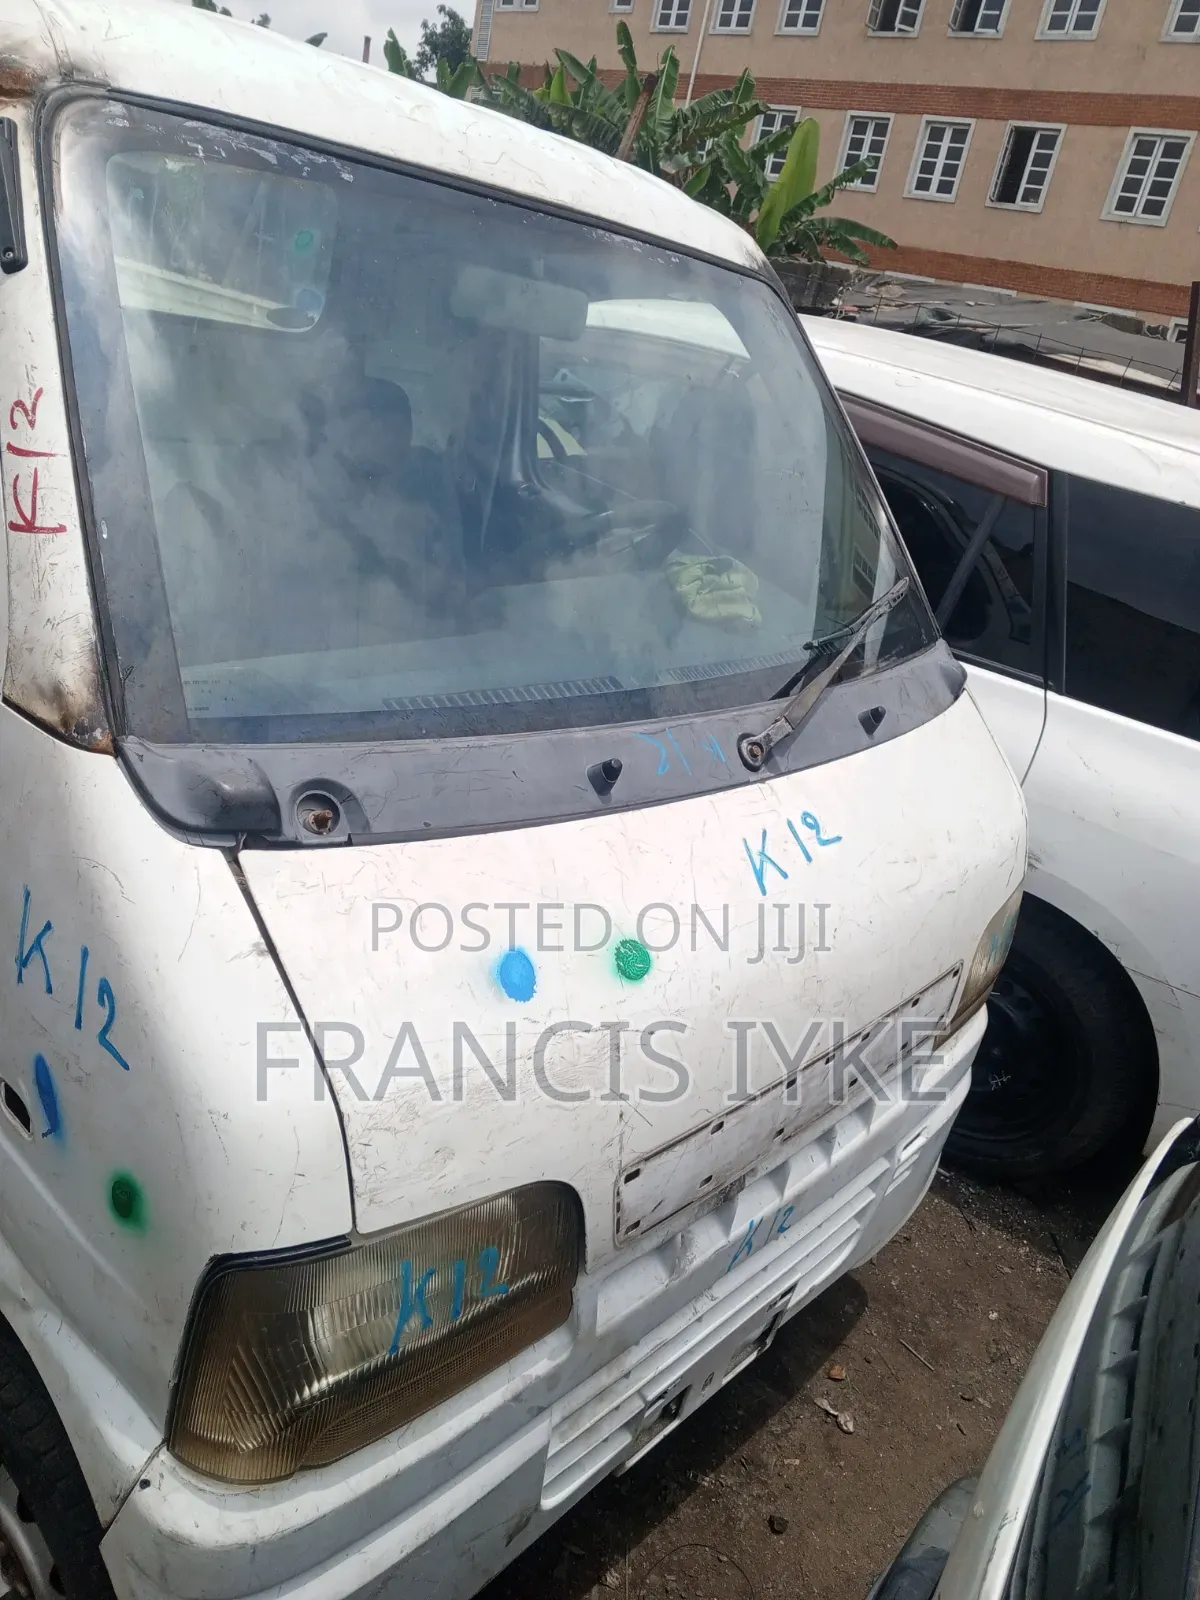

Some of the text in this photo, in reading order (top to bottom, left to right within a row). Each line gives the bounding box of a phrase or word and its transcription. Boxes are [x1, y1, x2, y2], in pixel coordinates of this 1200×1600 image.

[6, 387, 68, 534] K12
[742, 811, 843, 896] K12
[15, 885, 130, 1071] K12
[727, 1205, 796, 1272] K12
[388, 1245, 510, 1356] K12
